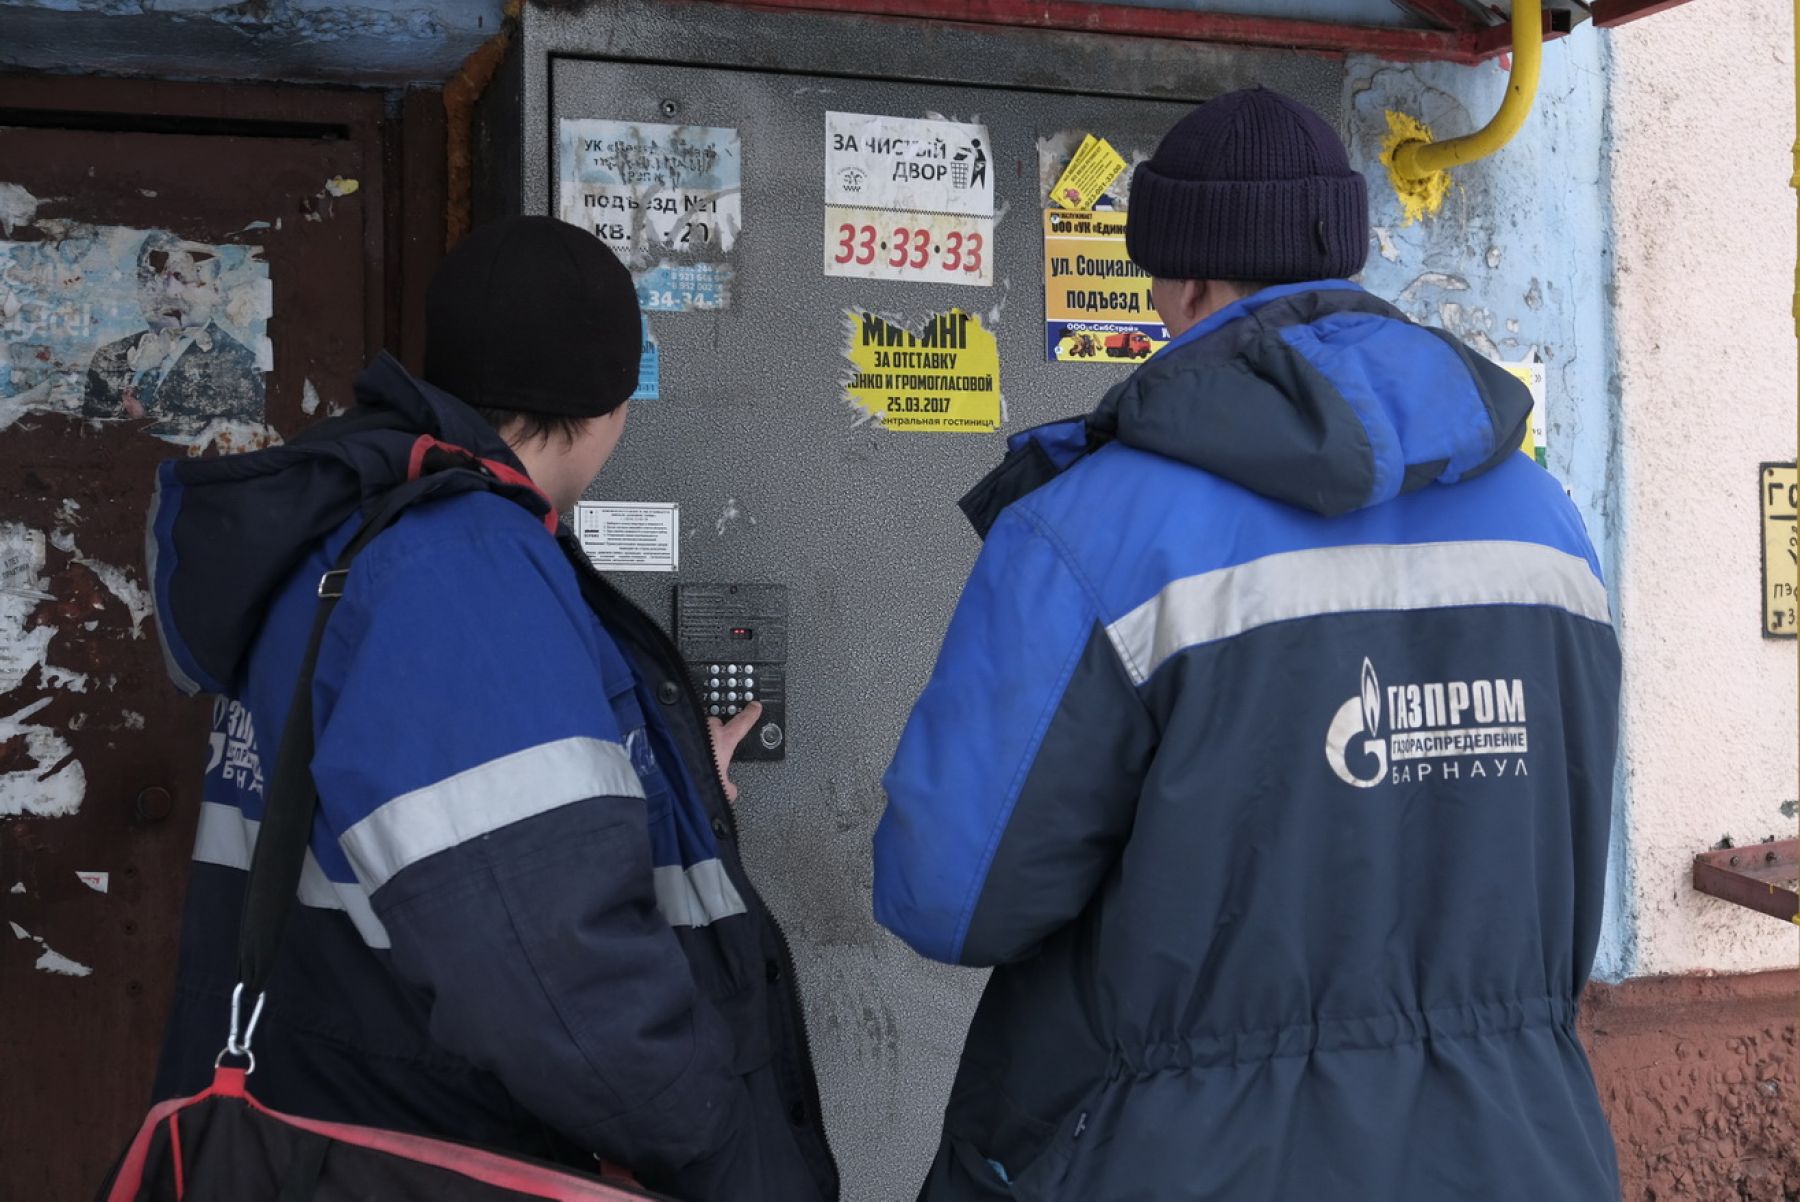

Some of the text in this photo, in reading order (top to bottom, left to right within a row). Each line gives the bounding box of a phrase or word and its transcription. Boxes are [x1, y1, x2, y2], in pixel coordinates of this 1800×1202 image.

[584, 139, 602, 152] УК
[833, 133, 858, 152] ЗА
[892, 161, 948, 182] ДВОР
[1052, 221, 1072, 233] ООО
[1051, 257, 1073, 277] ул.
[1066, 289, 1140, 313] подъезд
[1067, 323, 1085, 331] ООО
[874, 351, 957, 369] ЗА ОТСТАВКУ
[885, 374, 893, 390] И
[896, 373, 993, 391] ГРОМОГЛАСОВОЙ
[887, 396, 951, 413] 25.03.2017
[1387, 679, 1527, 730] ГАЗПРОМ
[1392, 732, 1526, 754] ГАЗОРАСПРЕДЕЛЕНИЕ
[1392, 757, 1529, 785] БАРНАУЛ
